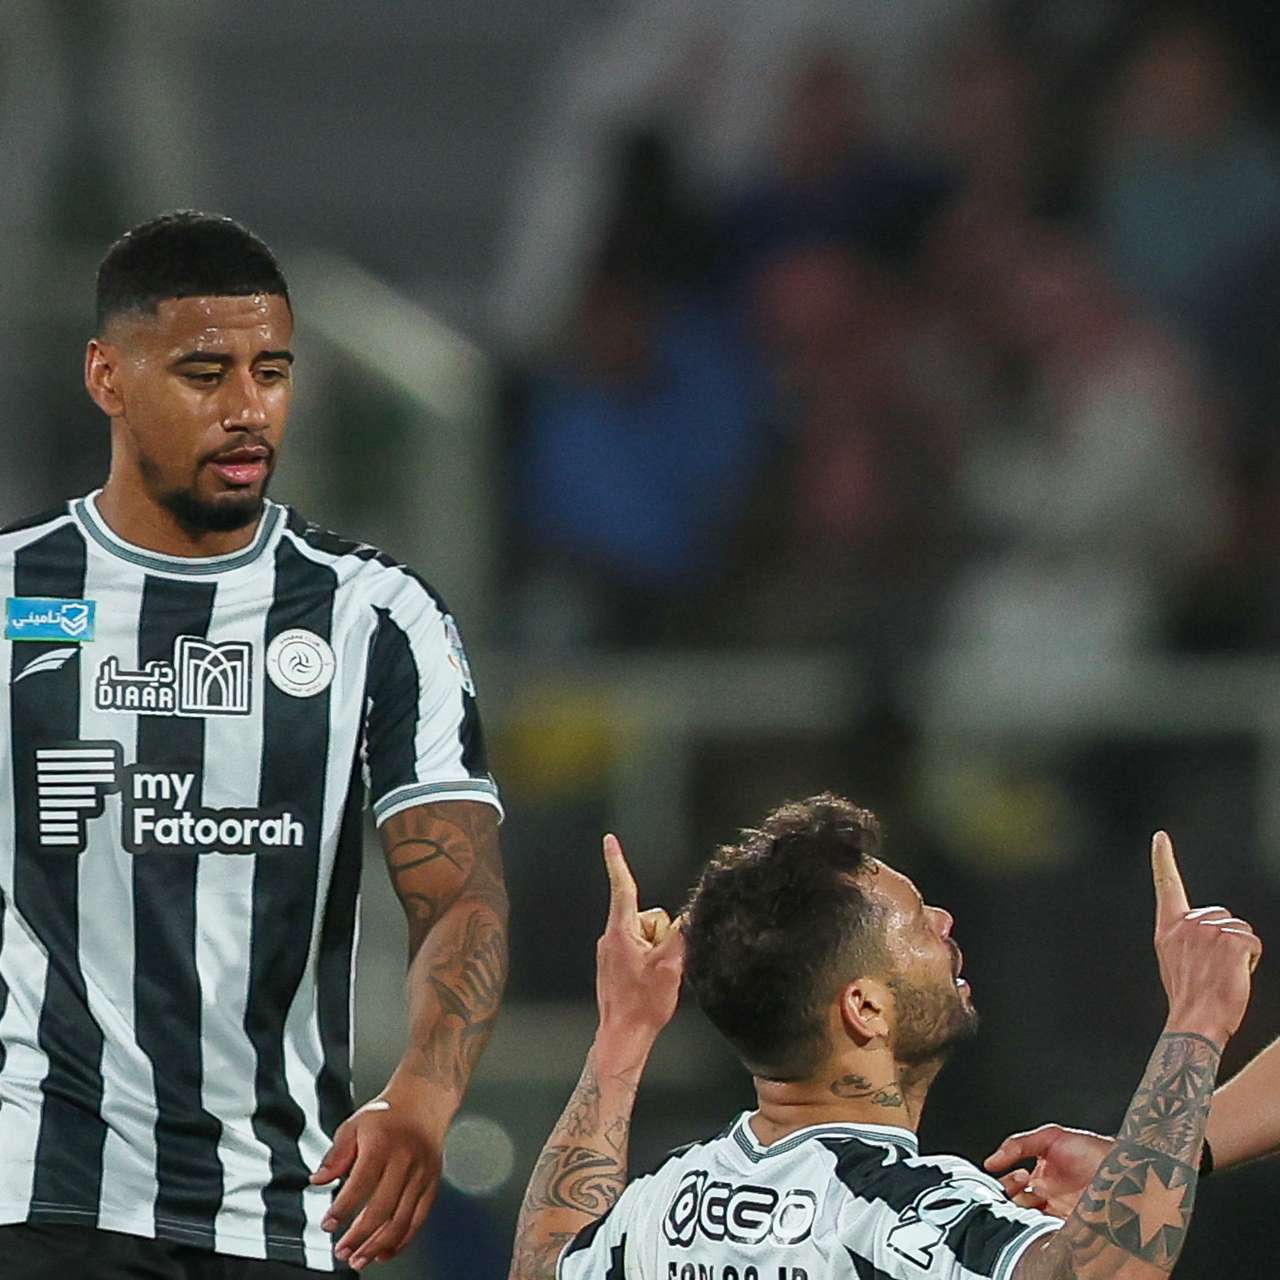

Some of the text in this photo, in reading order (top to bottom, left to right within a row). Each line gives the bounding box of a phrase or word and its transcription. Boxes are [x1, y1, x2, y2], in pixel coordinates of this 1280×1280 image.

[99, 685, 174, 708] DIAAR
[133, 773, 195, 810] my
[134, 808, 304, 846] Fatoorah
